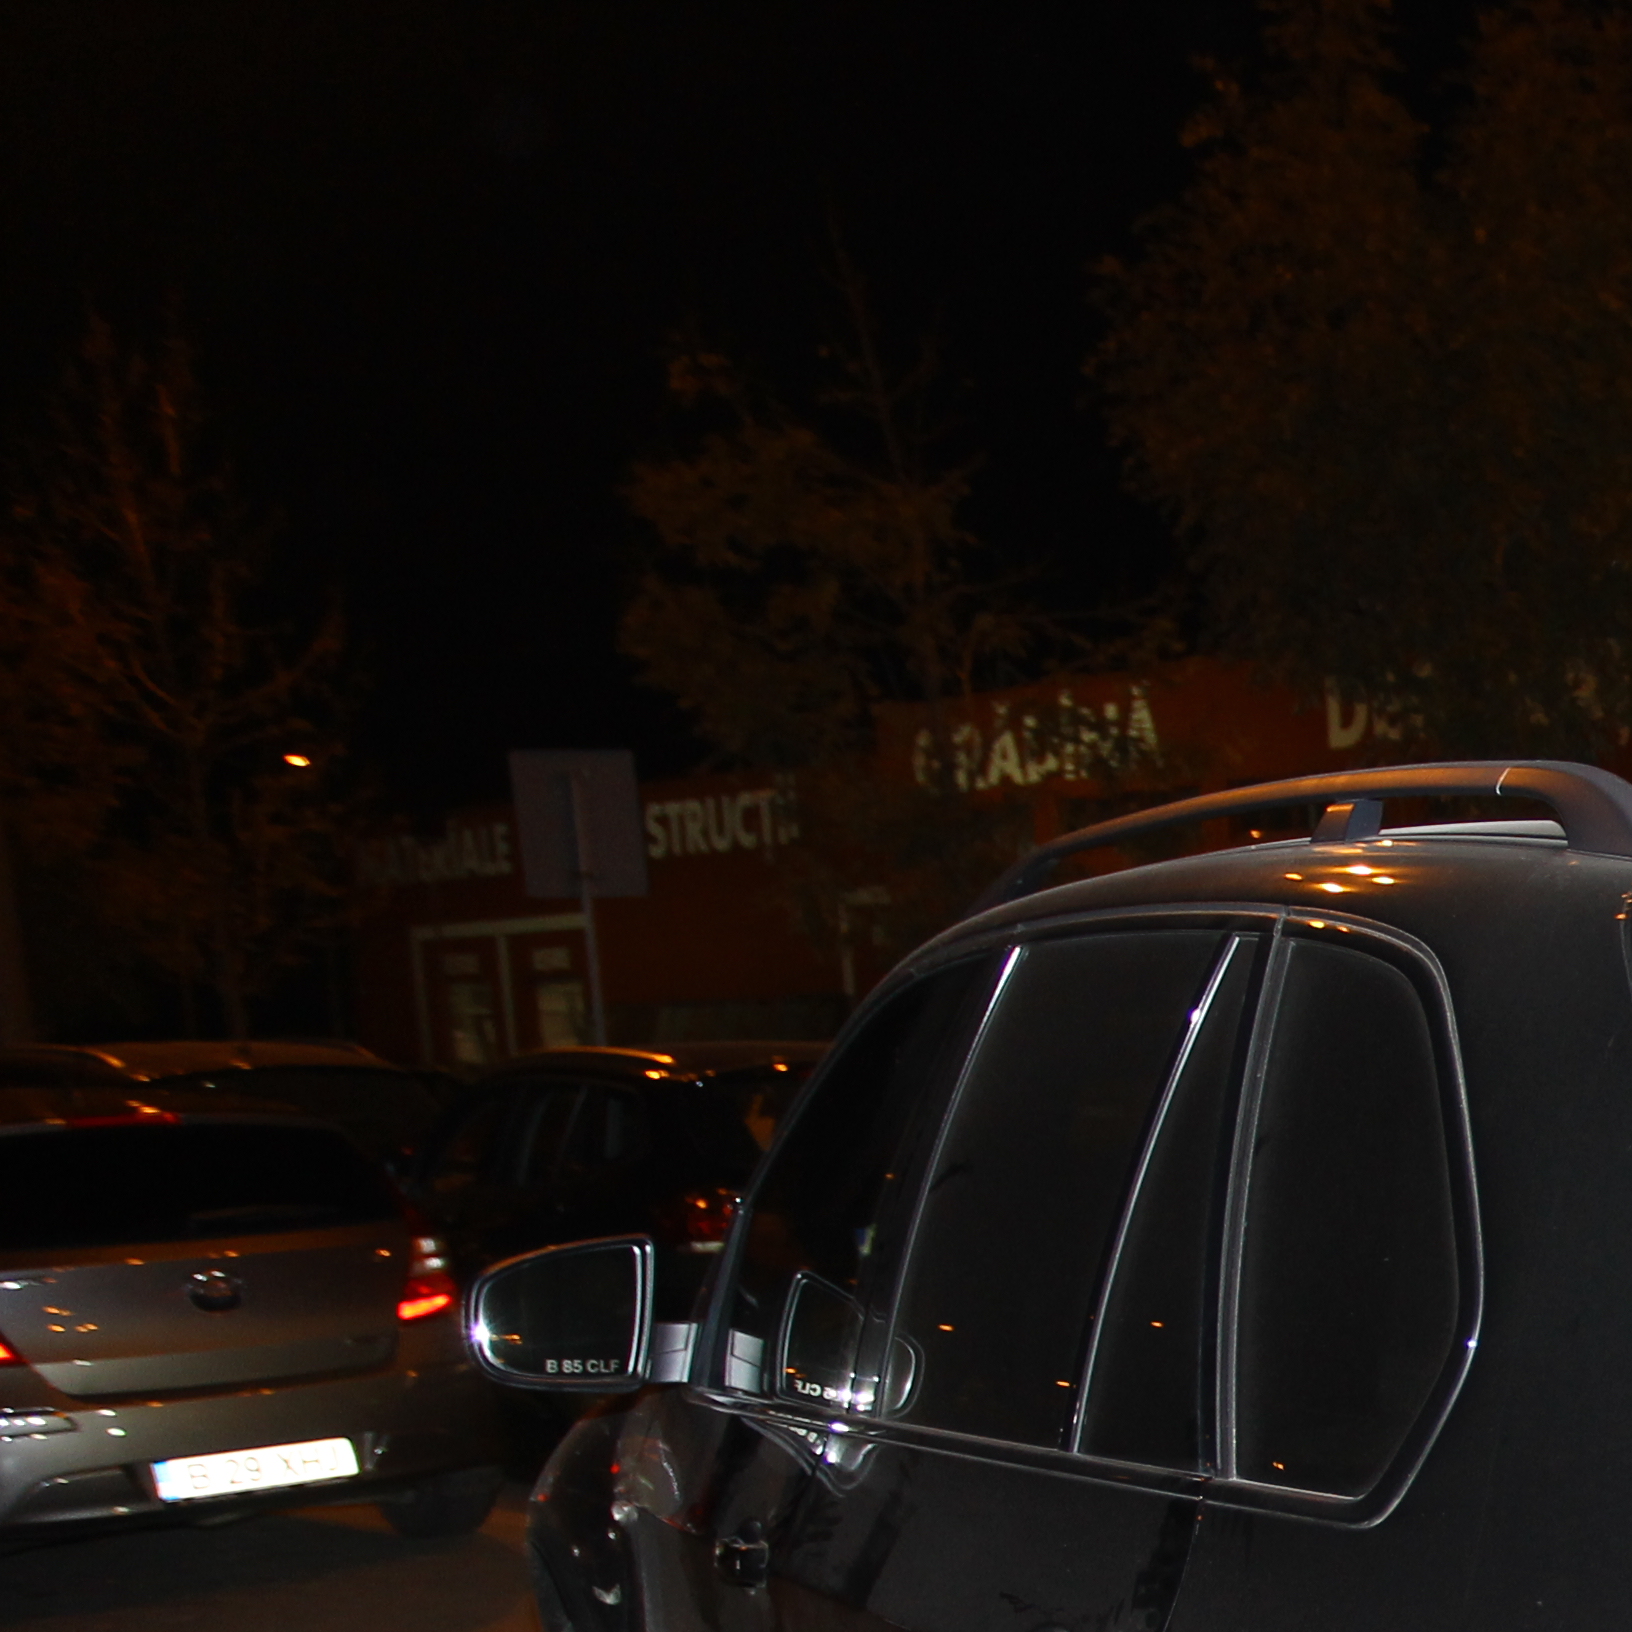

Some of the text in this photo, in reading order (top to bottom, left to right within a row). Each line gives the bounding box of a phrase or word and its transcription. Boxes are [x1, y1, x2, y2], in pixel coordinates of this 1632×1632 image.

[546, 1359, 620, 1373] B 85 CLF
[187, 1446, 338, 1490] B 29 XHJ
